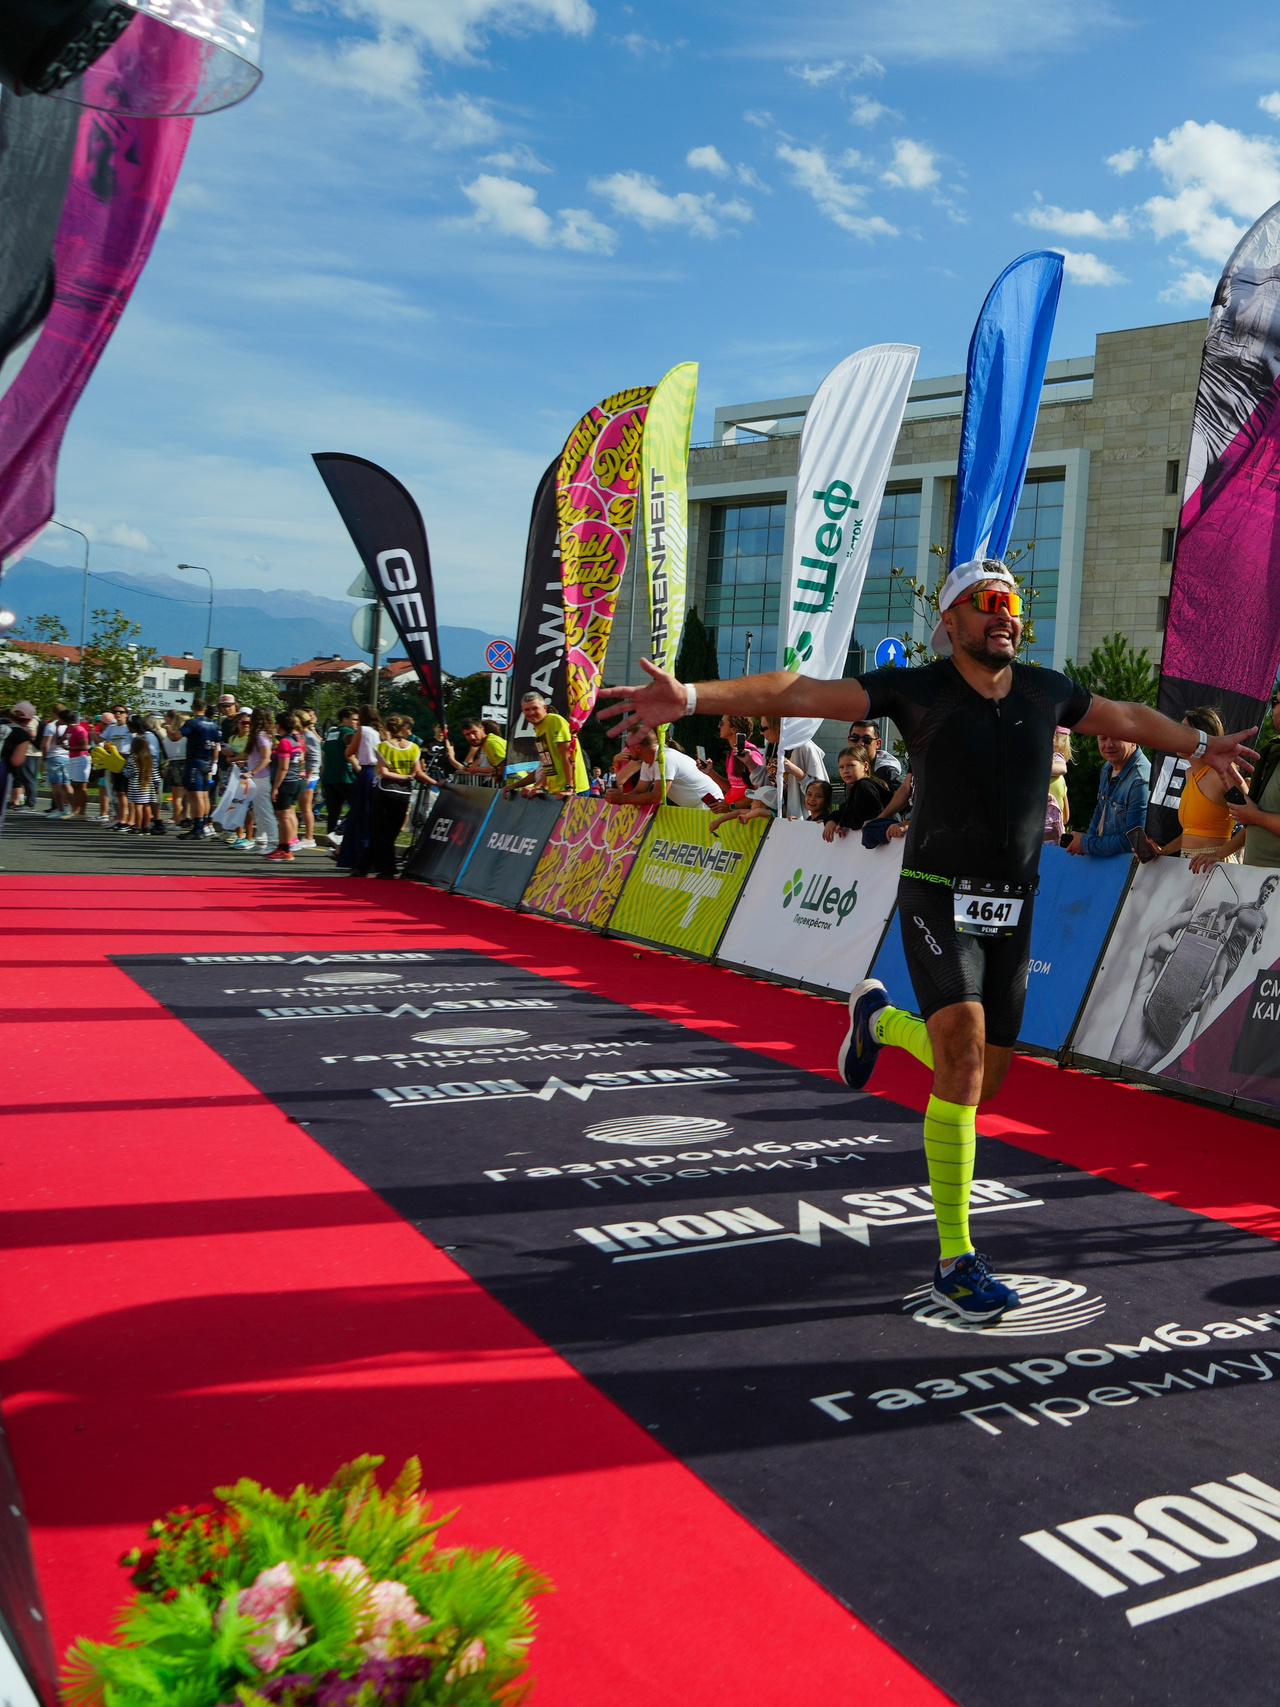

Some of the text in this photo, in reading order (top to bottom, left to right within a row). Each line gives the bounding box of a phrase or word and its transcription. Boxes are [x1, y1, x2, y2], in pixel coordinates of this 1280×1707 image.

[560, 531, 615, 563] Dubl
[793, 479, 860, 614] Шеф
[562, 555, 622, 599] Bubl
[648, 839, 744, 875] FAHRENHEIT
[641, 864, 683, 890] VITAMIN
[800, 873, 859, 927] Шеф
[966, 901, 1012, 922] 4647
[793, 913, 832, 931] Перекрёсток
[181, 953, 434, 965] IRON STAR
[223, 981, 501, 995] Газпромбанк
[257, 998, 554, 1018] IRON STAR
[320, 1039, 654, 1065] Газпромбанк
[392, 1050, 623, 1069] Премиум
[372, 1067, 733, 1102] IRON STAR
[482, 1134, 894, 1182] Газпромбанк
[580, 1152, 866, 1190] Премиум
[573, 1179, 1031, 1254] IRON STR
